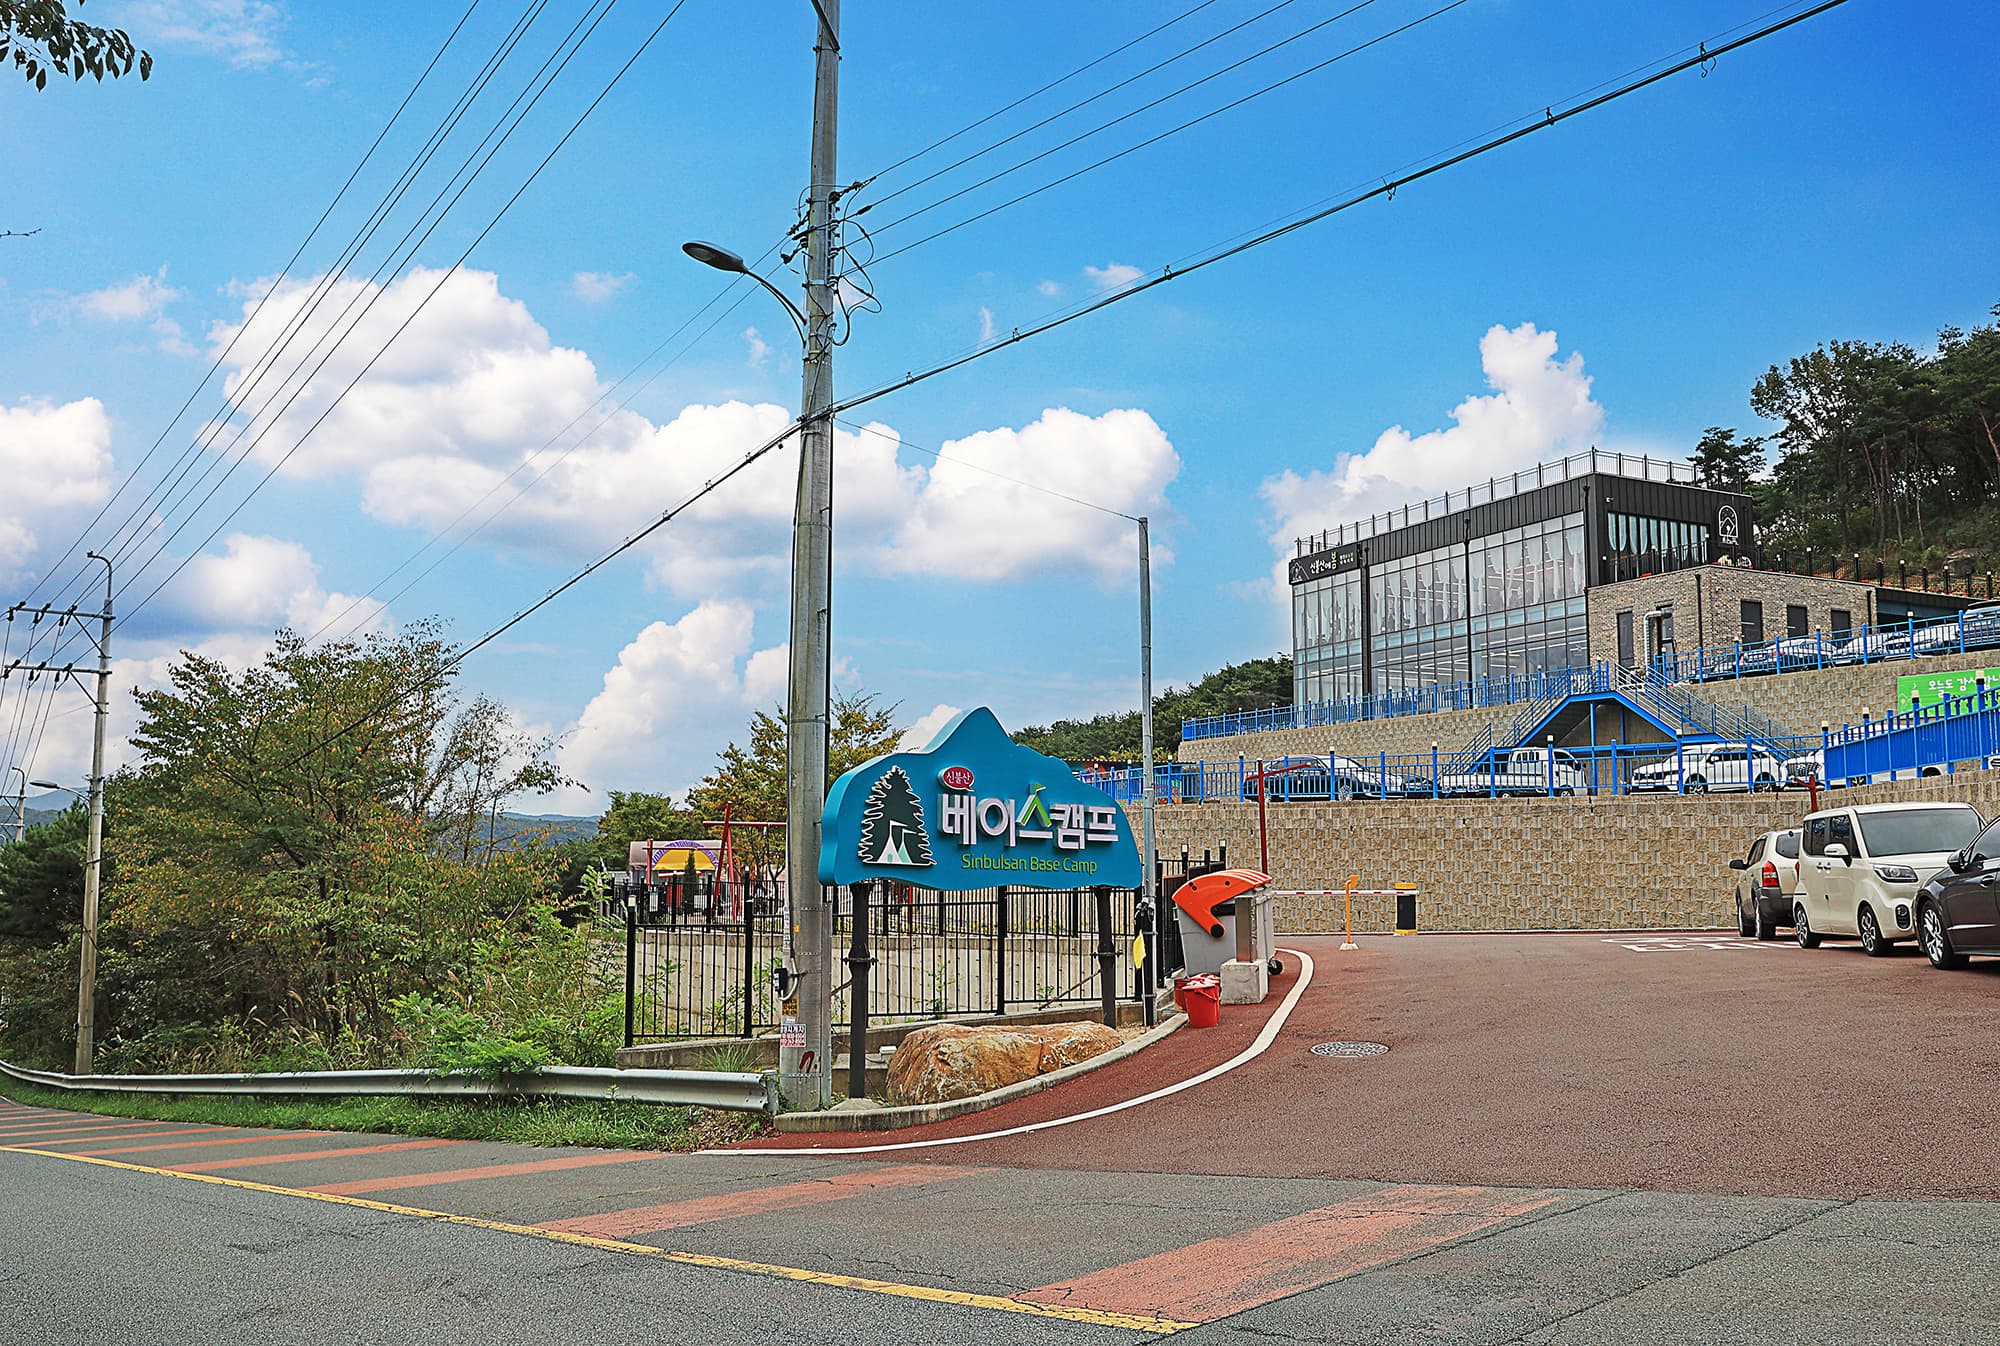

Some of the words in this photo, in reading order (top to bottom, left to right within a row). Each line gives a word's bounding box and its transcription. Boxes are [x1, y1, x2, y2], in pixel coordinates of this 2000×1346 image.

[1929, 679, 1953, 698] 오늘도
[946, 771, 971, 785] 신불산
[939, 788, 1119, 849] 베이스캠프
[961, 854, 1027, 870] Sinbulsan
[1030, 857, 1060, 872] Base
[1062, 858, 1097, 875] Camp
